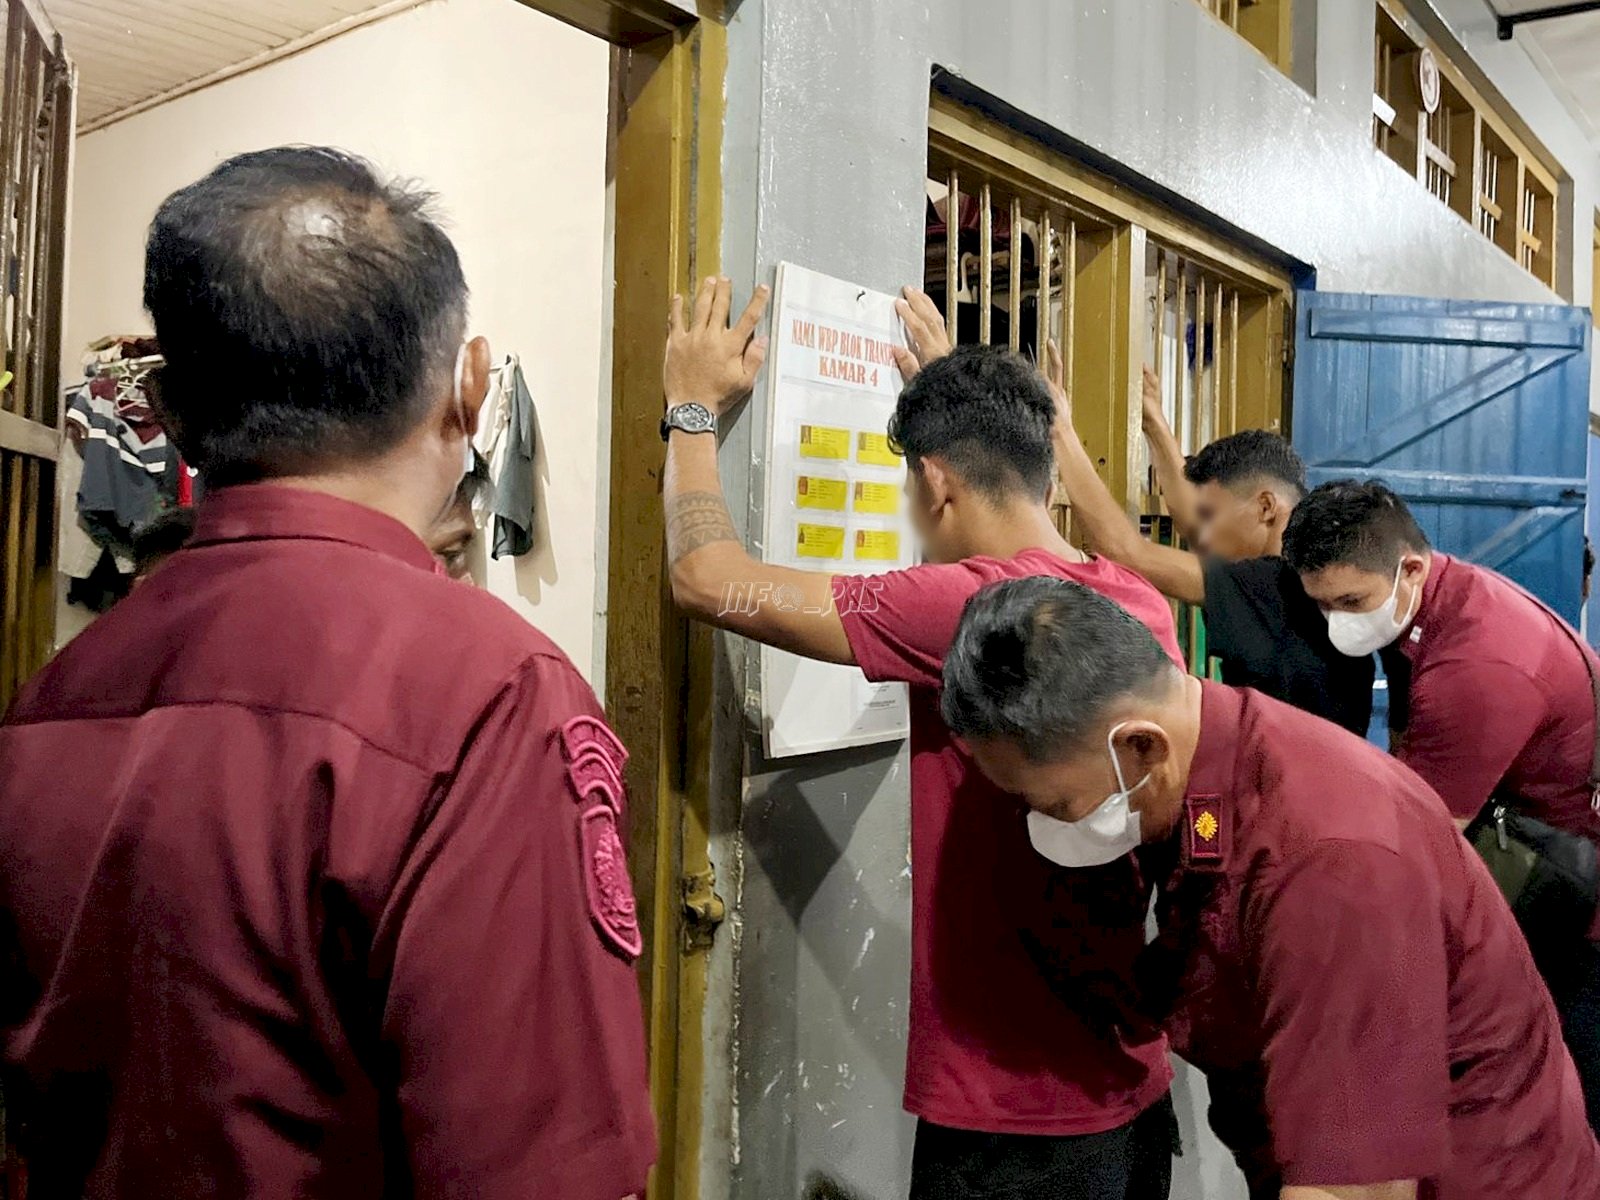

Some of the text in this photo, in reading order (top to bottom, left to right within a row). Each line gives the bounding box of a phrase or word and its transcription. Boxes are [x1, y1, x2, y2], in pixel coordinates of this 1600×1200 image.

[792, 319, 815, 349] NAMA
[818, 324, 839, 353] WBP
[840, 331, 862, 360] BLOK
[819, 355, 878, 387] KAMAR 4
